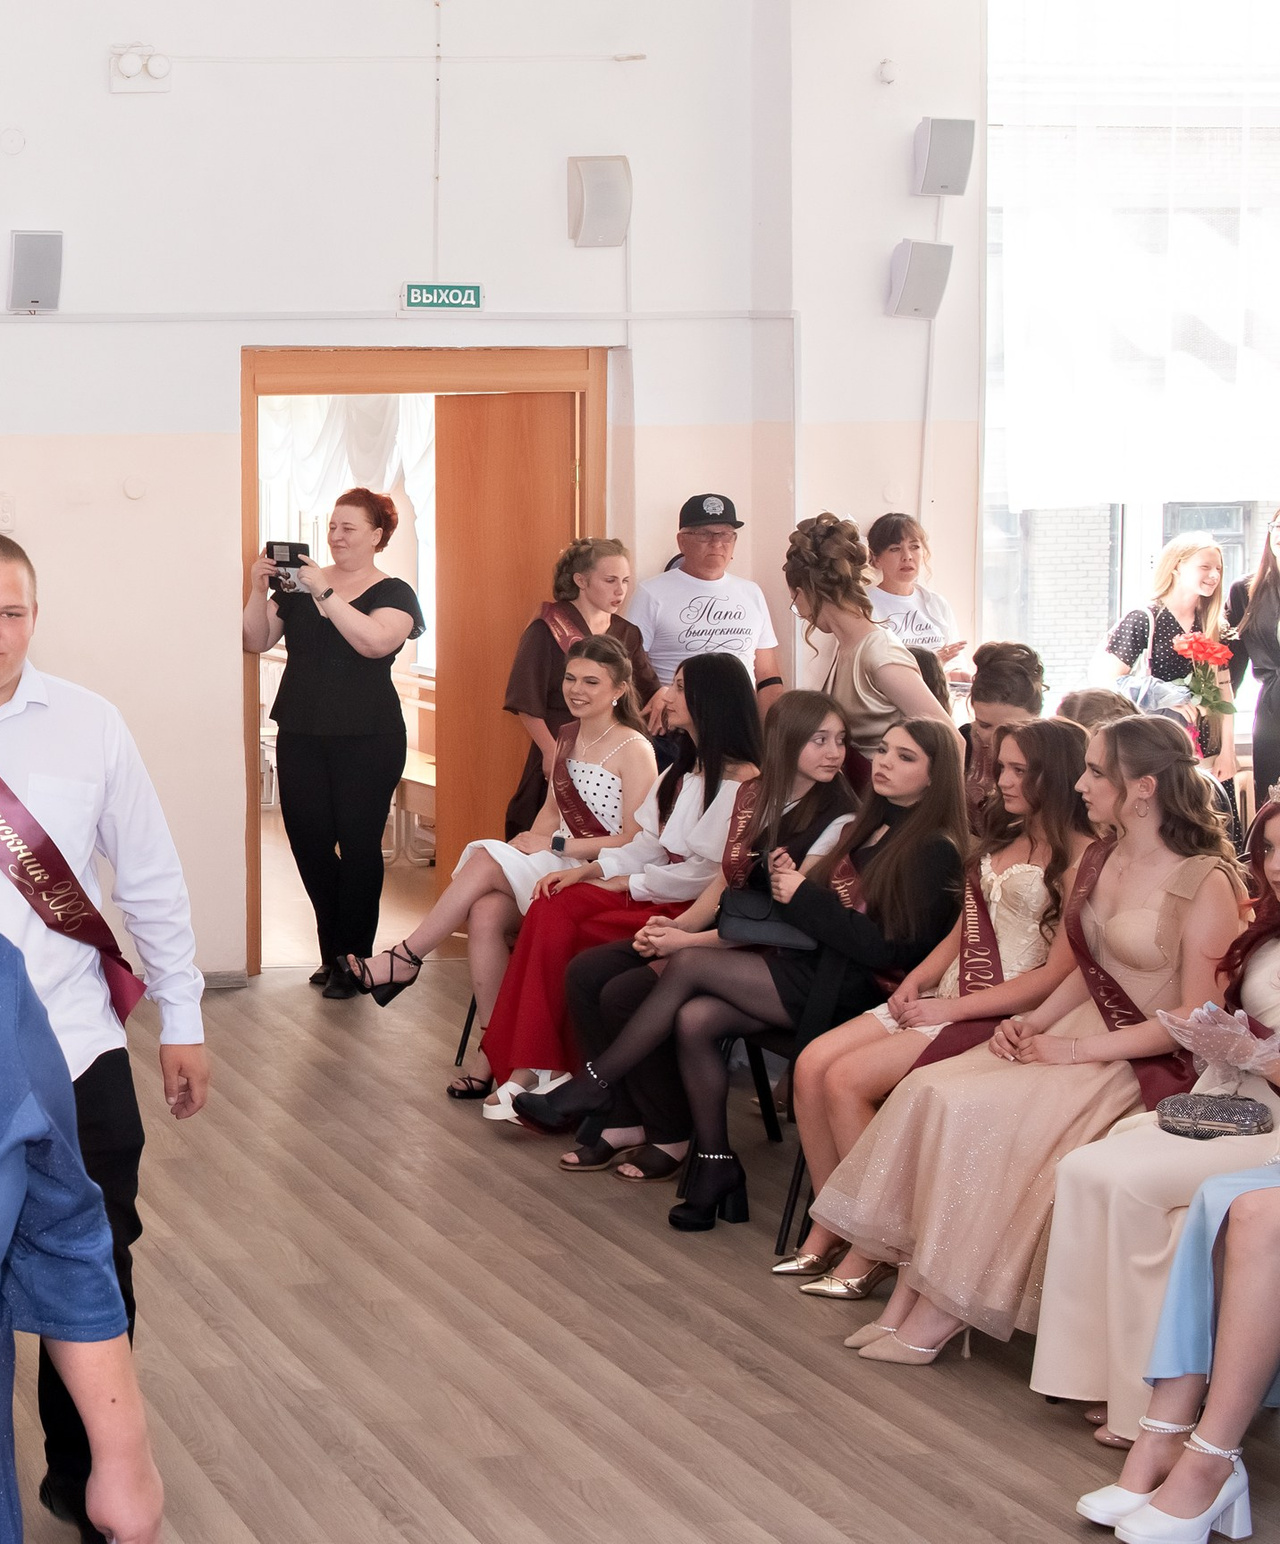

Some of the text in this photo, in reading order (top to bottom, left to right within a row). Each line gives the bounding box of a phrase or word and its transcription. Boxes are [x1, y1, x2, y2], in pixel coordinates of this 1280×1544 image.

[410, 288, 476, 306] ВЫХОД
[679, 595, 747, 626] Папа
[887, 609, 933, 636] Мам
[678, 622, 754, 651] выпускника
[41, 881, 94, 932] 2026
[963, 947, 995, 993] 2026
